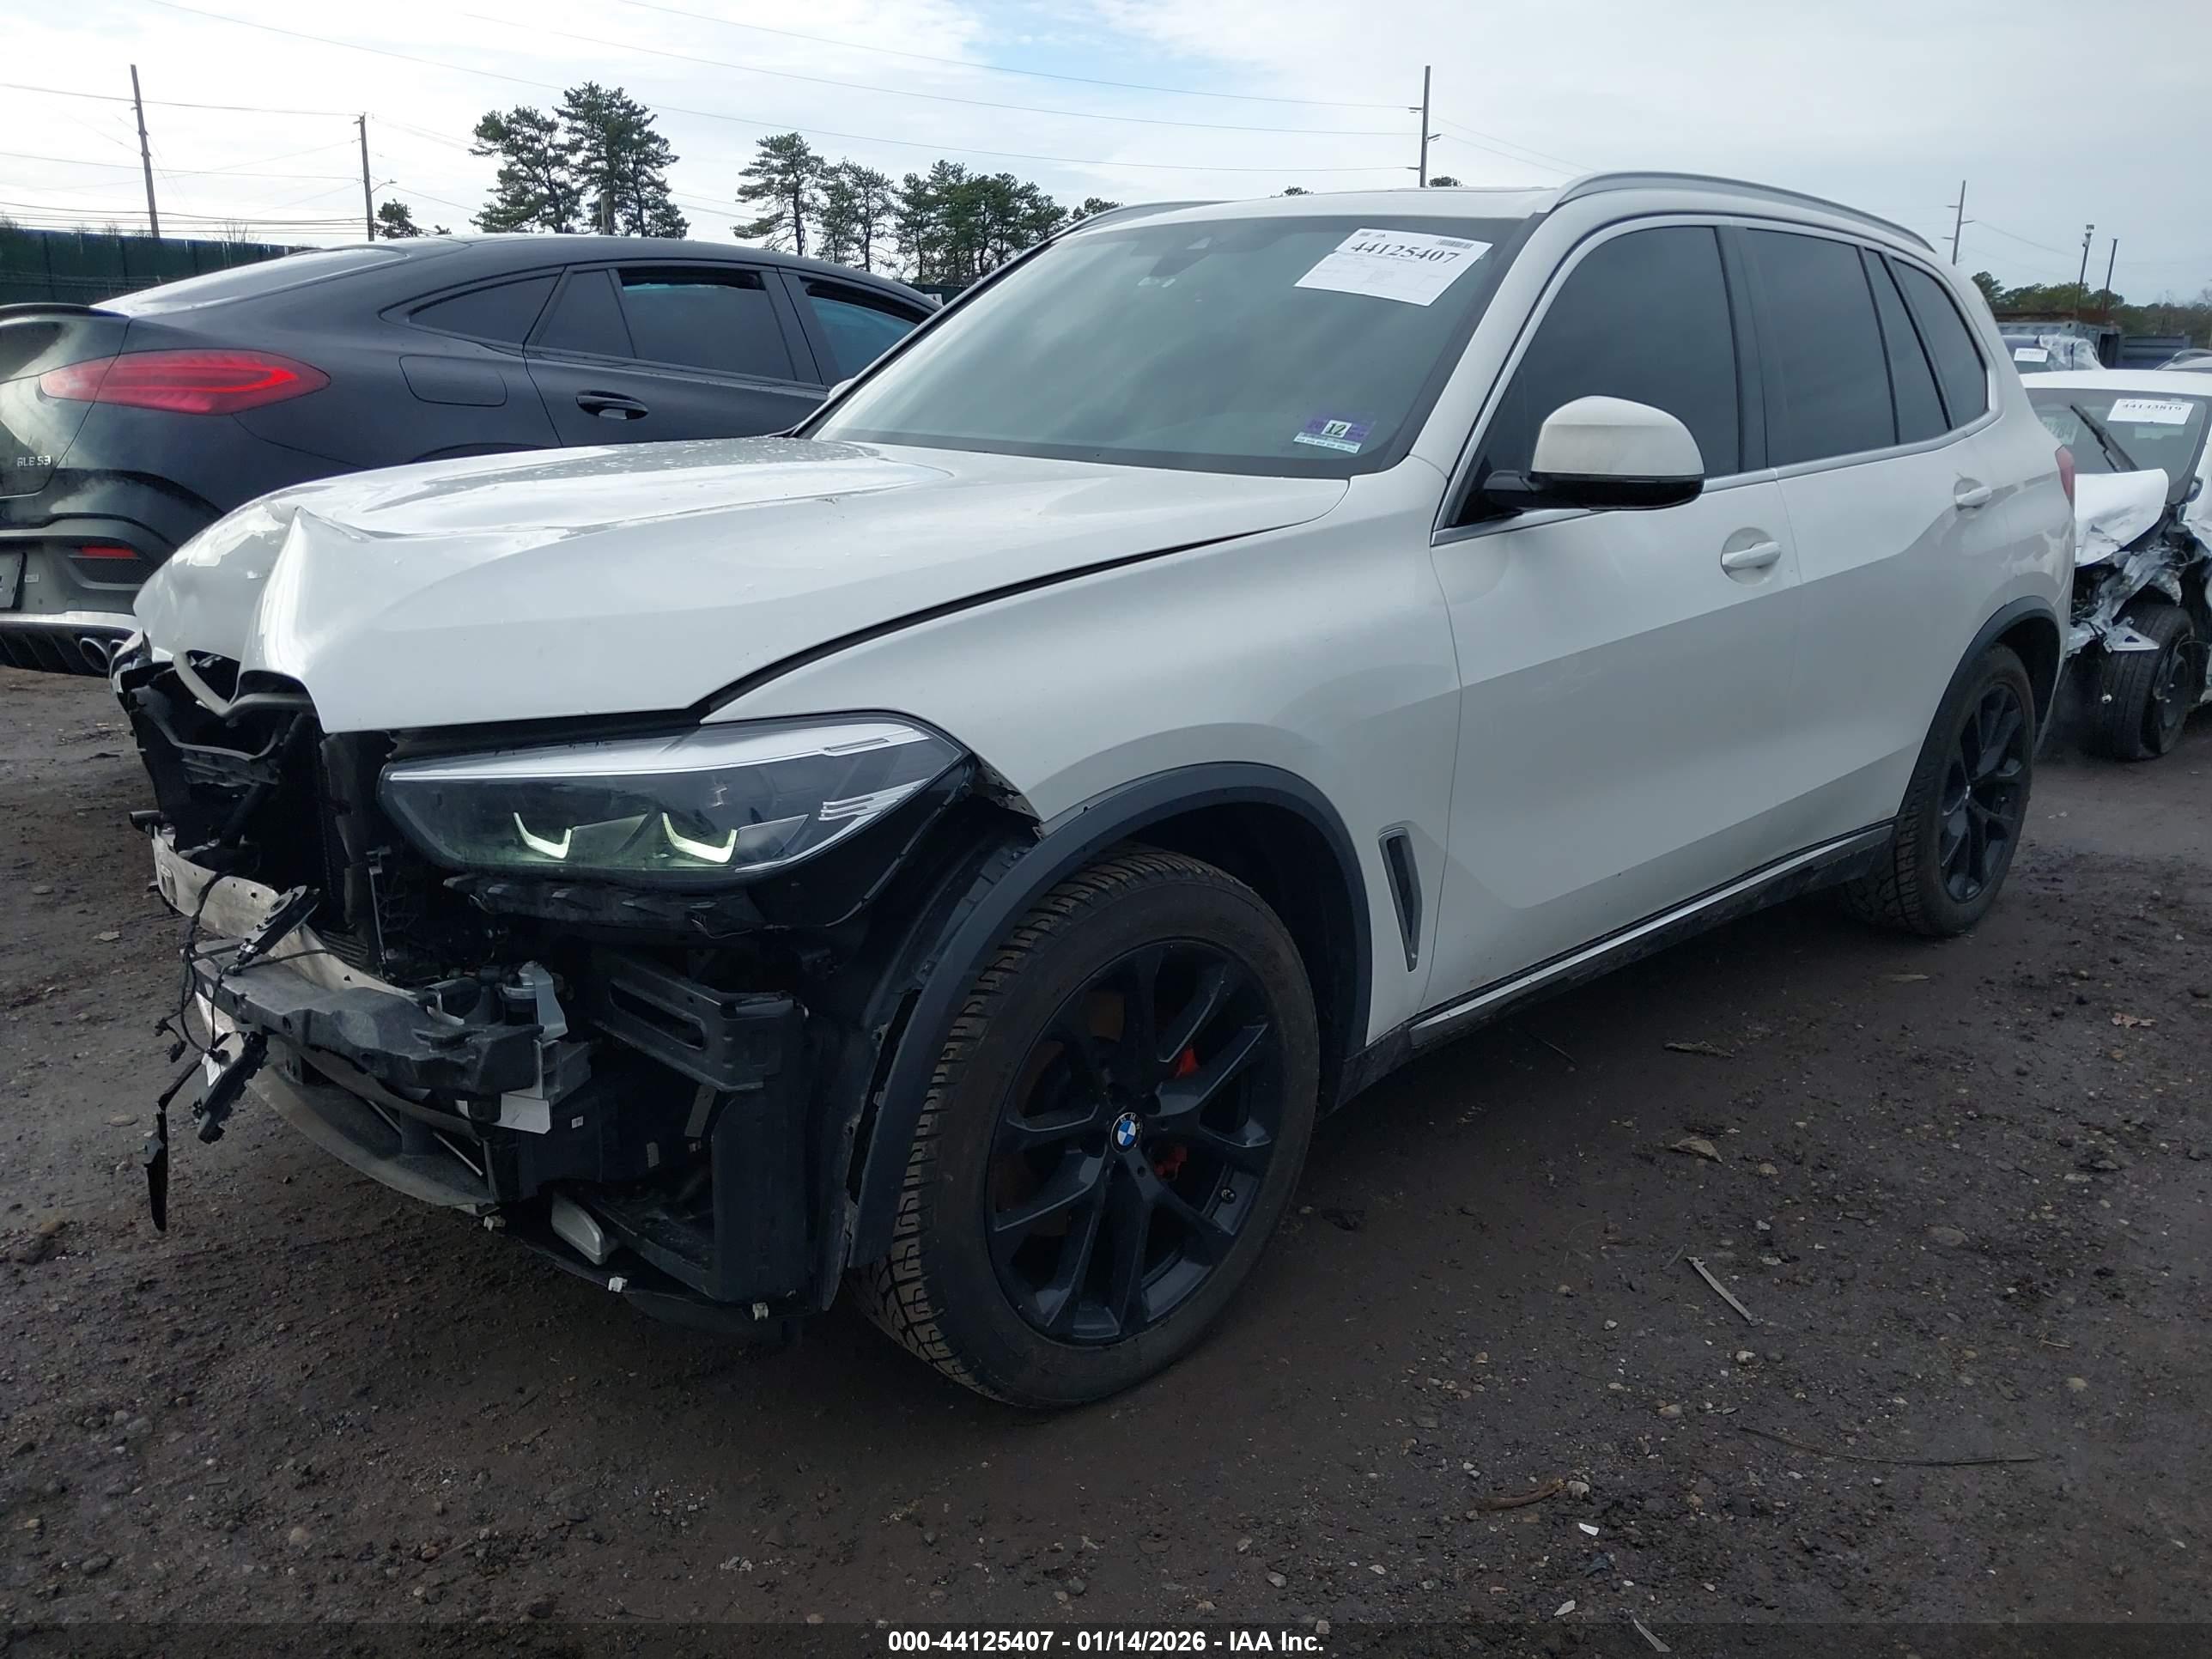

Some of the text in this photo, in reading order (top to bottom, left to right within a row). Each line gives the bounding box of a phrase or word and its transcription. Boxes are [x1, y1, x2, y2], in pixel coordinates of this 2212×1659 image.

[1351, 241, 1462, 264] 44125407
[1325, 422, 1346, 436] 12
[16, 455, 52, 467] GLE 53
